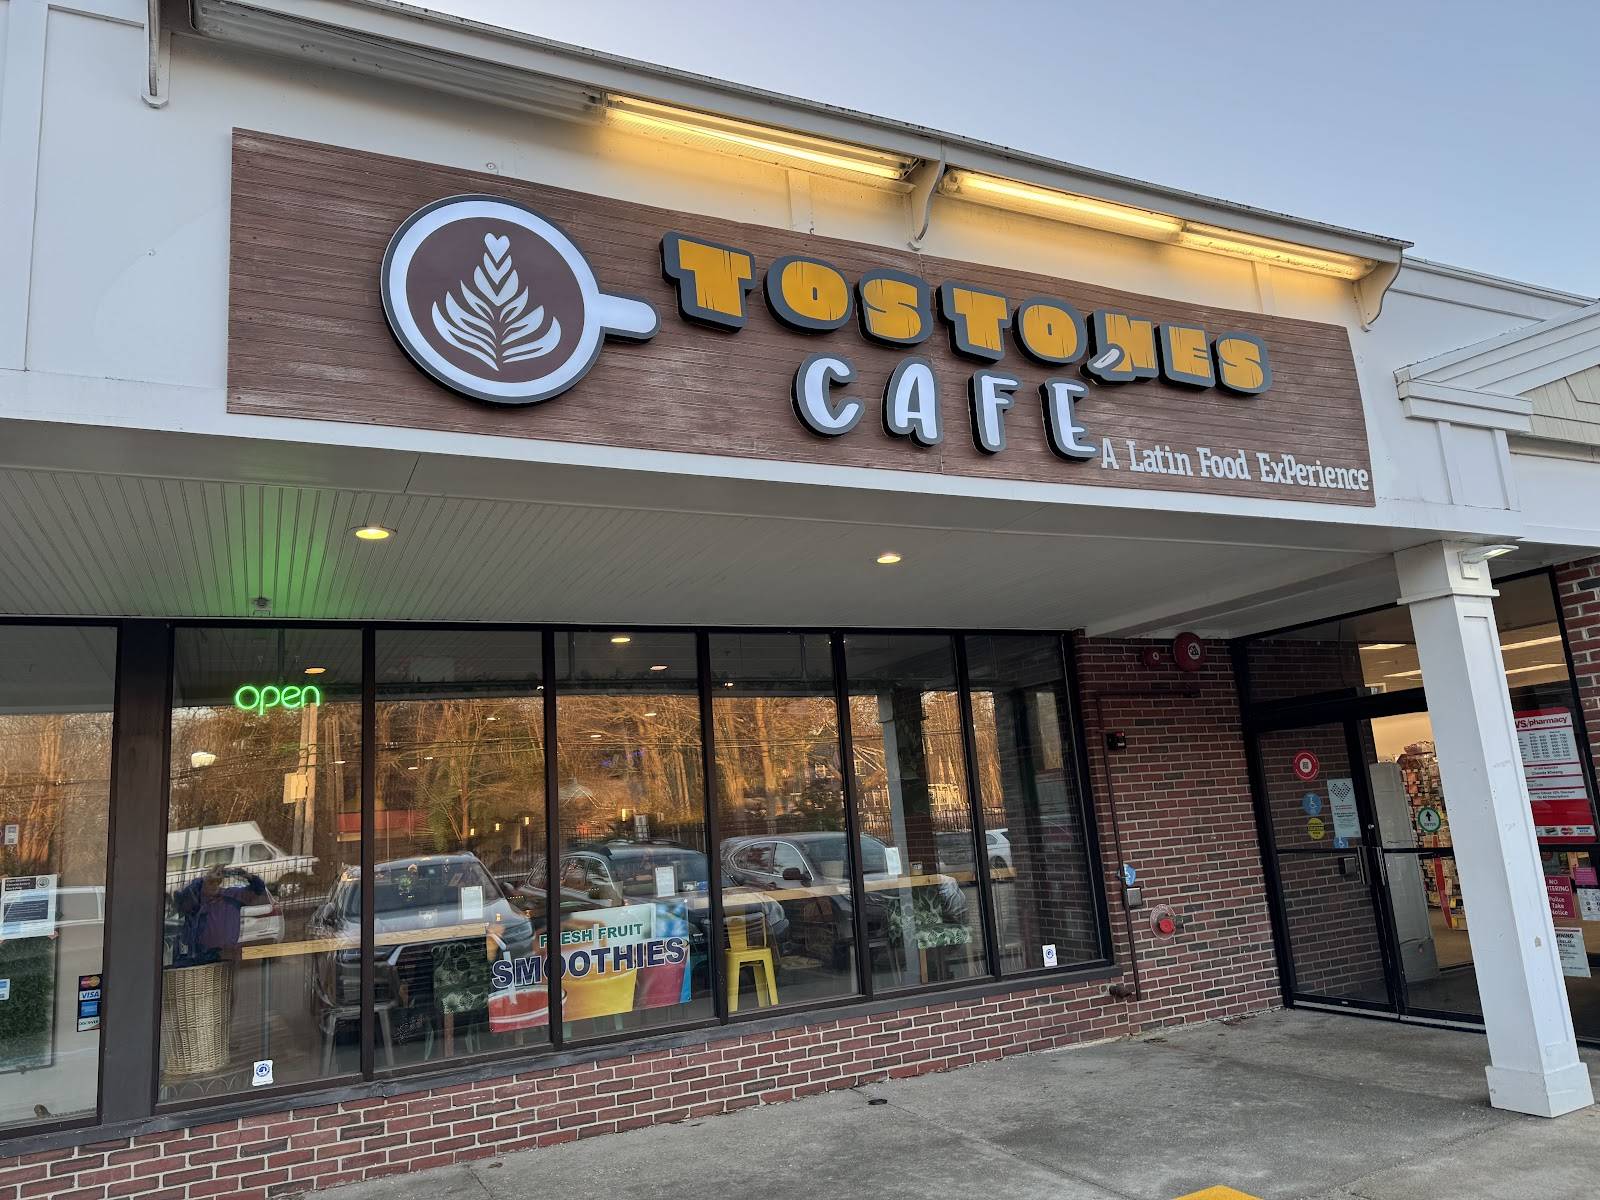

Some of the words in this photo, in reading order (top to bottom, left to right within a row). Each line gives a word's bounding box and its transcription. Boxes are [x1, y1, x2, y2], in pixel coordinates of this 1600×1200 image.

[792, 353, 1102, 460] CAFE
[1101, 437, 1119, 470] A
[1126, 440, 1193, 477] Latin
[1197, 447, 1251, 480] Food
[1256, 452, 1369, 491] ExPerience
[235, 685, 321, 715] open
[1514, 716, 1568, 729] VS/pharmacy
[540, 928, 593, 948] FESH
[598, 923, 644, 940] FRUIT
[82, 991, 100, 999] VISA
